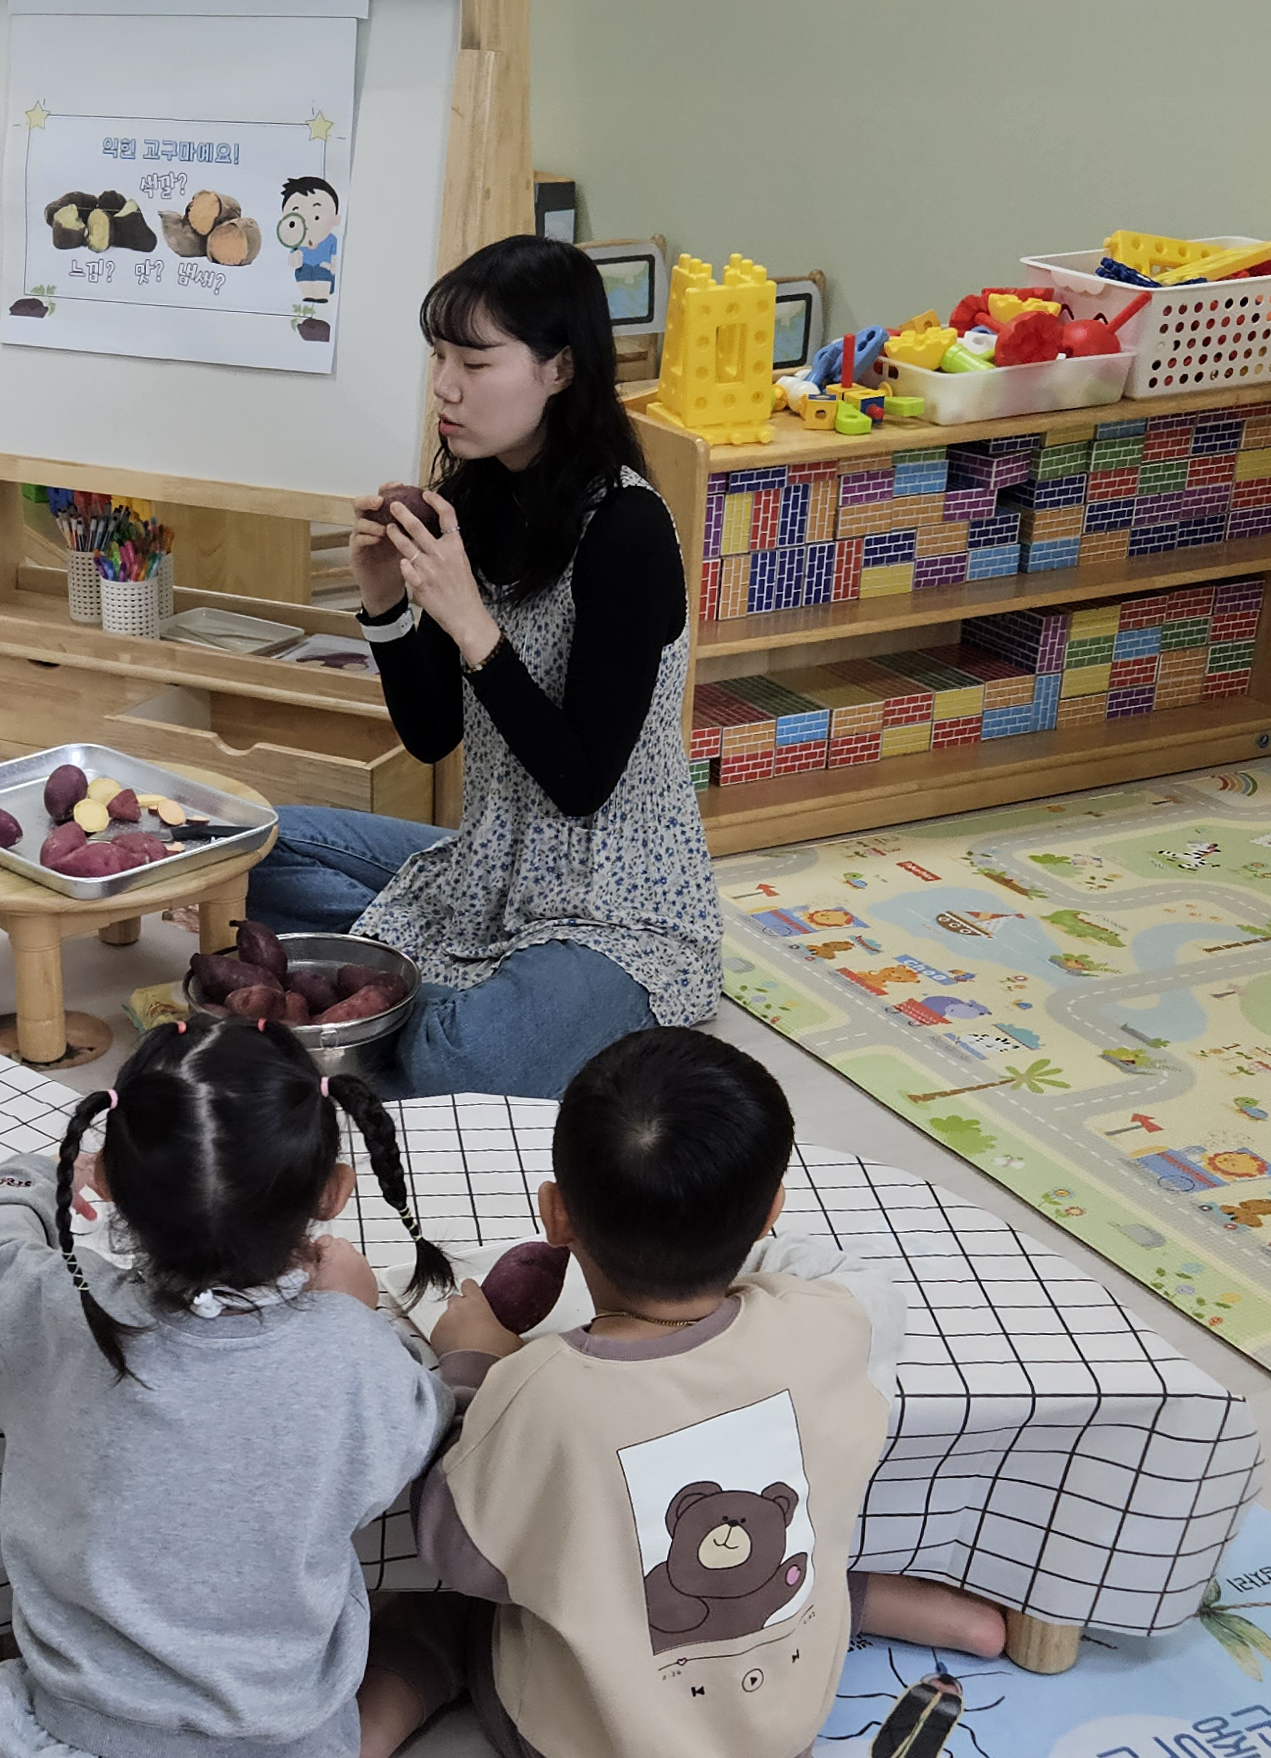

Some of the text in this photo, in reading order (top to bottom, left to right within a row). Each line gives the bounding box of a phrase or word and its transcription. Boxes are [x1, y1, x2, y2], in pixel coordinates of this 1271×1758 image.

[102, 137, 240, 165] 익힌 고구마예요!
[139, 171, 188, 199] 색깔?
[69, 259, 227, 295] 느낌? 맛? 냄새?
